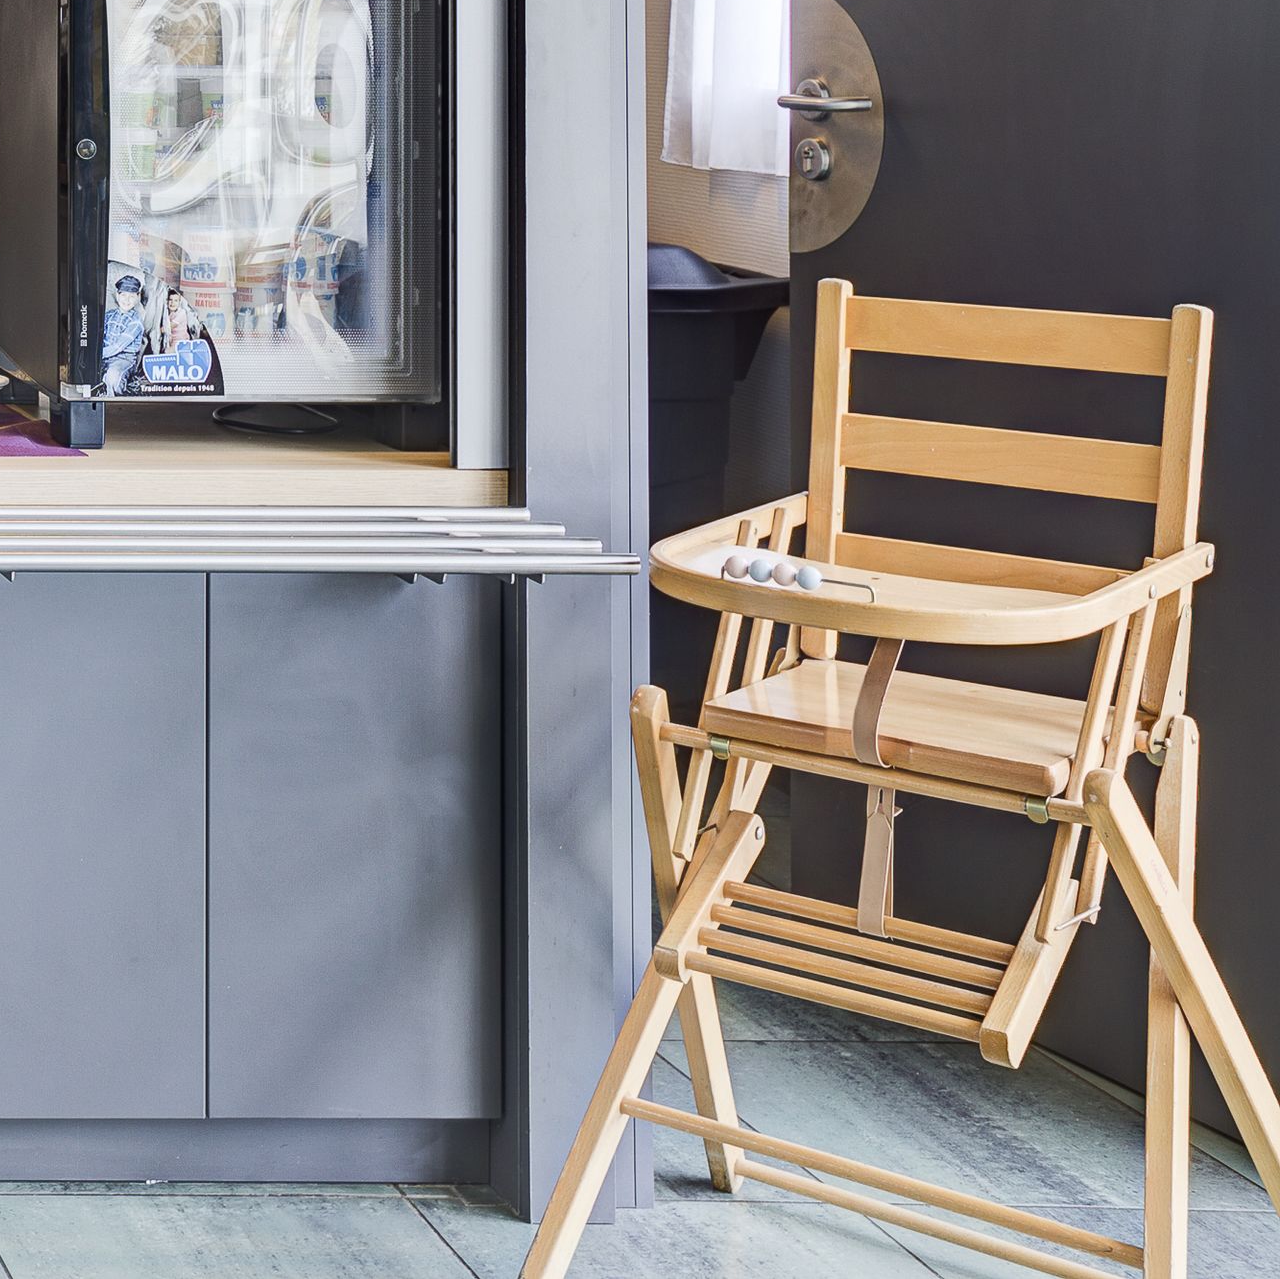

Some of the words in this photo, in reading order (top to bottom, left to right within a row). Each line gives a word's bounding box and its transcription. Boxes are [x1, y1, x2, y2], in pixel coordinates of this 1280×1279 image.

[80, 304, 88, 338] Dometic
[152, 365, 204, 381] MALO
[141, 384, 172, 393] Tradition
[173, 384, 197, 394] depuis
[197, 384, 215, 393] 1948
